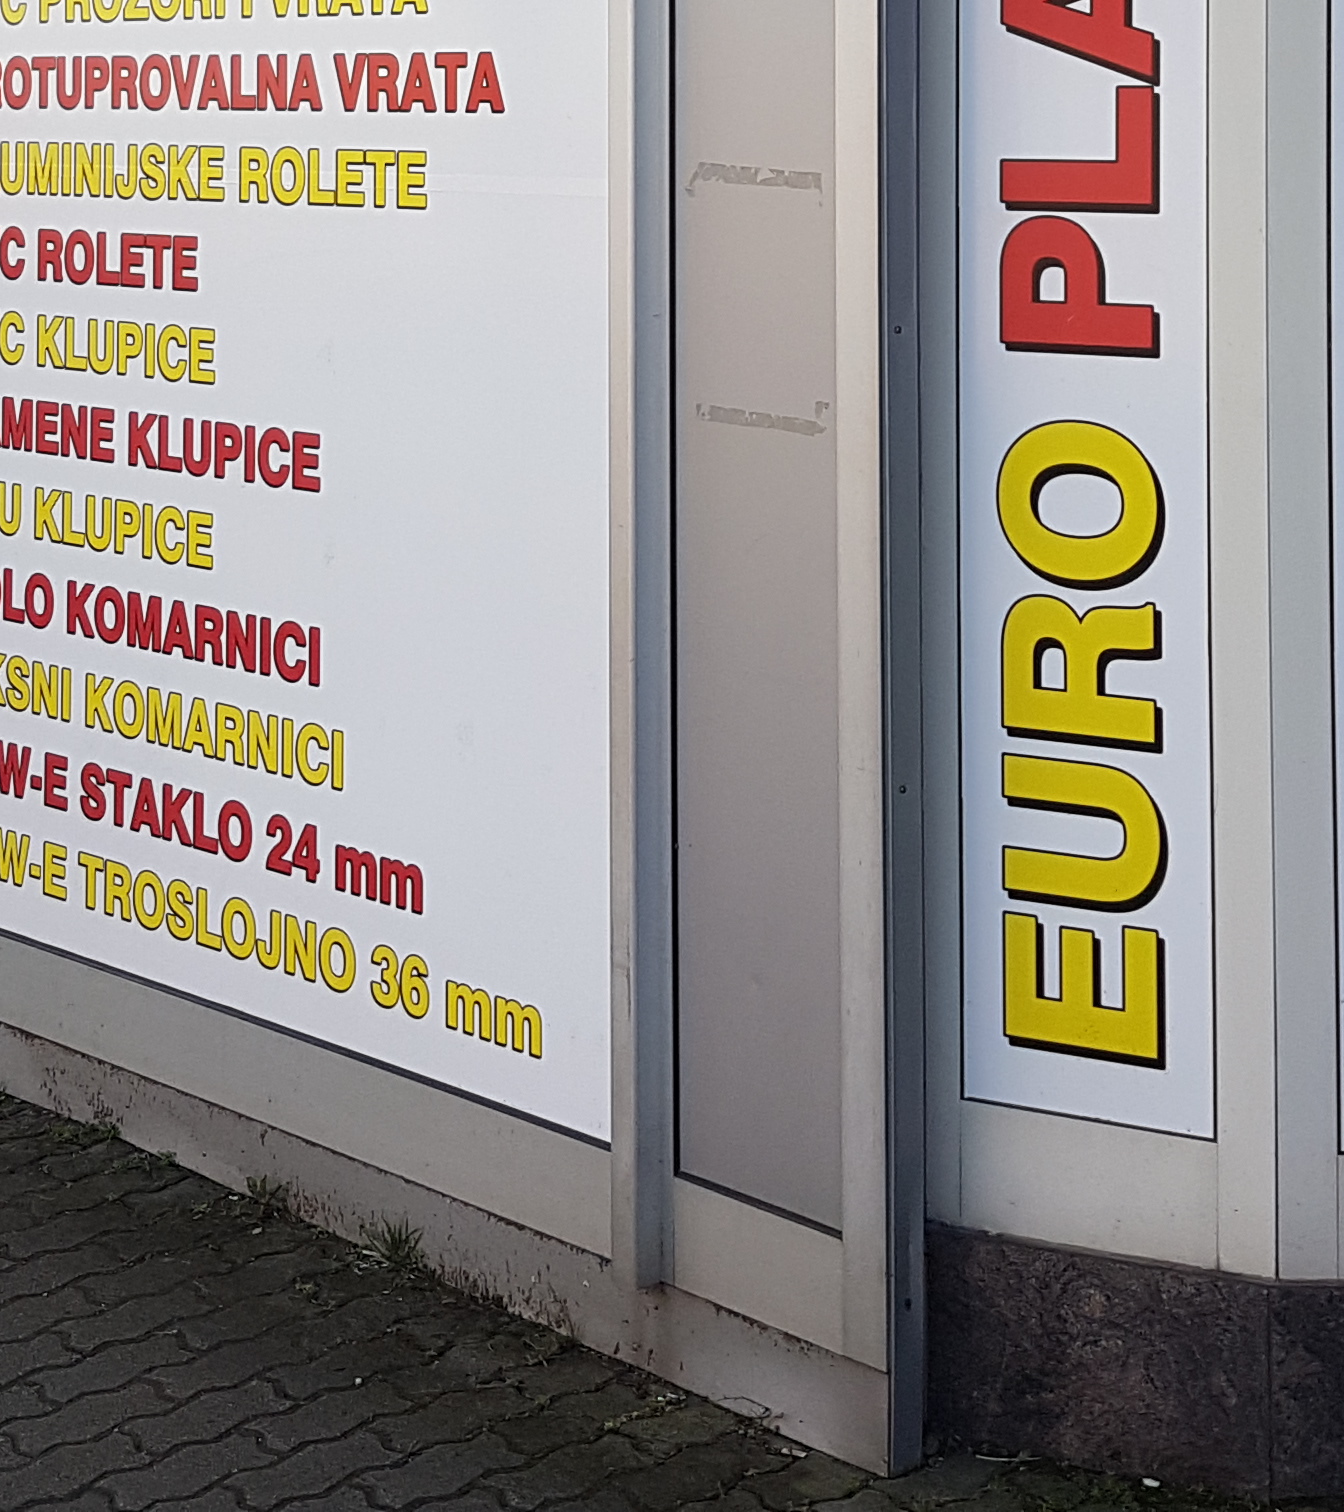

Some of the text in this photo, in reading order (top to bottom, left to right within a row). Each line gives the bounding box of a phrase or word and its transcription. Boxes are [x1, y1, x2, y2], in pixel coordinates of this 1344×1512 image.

[333, 51, 506, 114] VRATA
[238, 146, 429, 210] ROLETE
[37, 229, 199, 292] ROLETE
[36, 314, 217, 385] KLUPICE
[127, 411, 322, 493] KLUPICE
[34, 486, 214, 569] KLUPICE
[65, 579, 322, 687] KOMARNICI
[84, 672, 345, 791] KOMARNICI
[995, 416, 1169, 1072] EURO
[80, 762, 253, 861] STAKLO
[266, 812, 322, 883] 24
[335, 842, 425, 915] mm
[78, 850, 357, 995] TROSLOJNO
[370, 943, 431, 1020] 36
[444, 978, 544, 1060] mm
